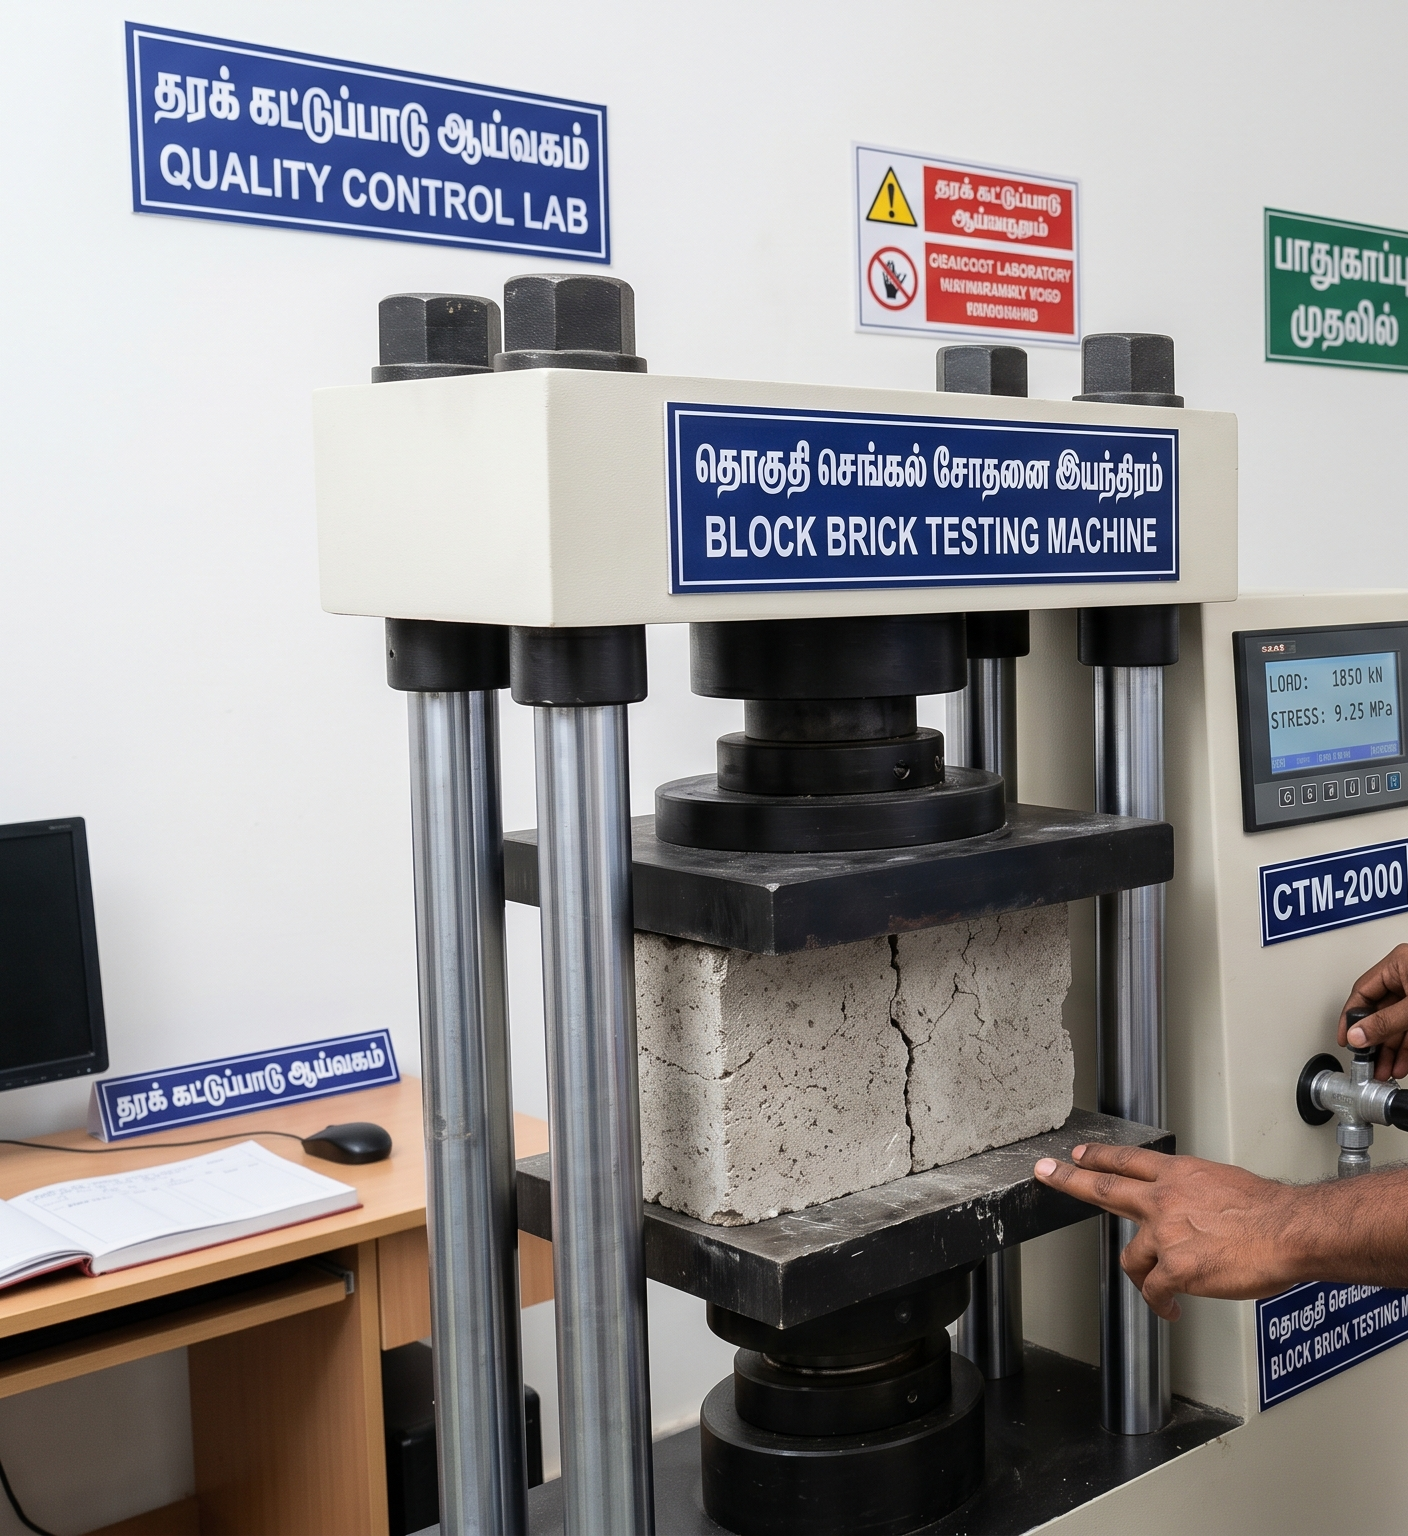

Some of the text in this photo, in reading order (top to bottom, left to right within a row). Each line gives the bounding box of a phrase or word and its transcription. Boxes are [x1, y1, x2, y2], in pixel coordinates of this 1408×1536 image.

[155, 66, 589, 170] தரக் கட்டுப்பாடு ஆய்வகம்
[160, 144, 588, 234] QUALITY CONTROL LAB
[997, 262, 1071, 282] LABORATORY
[1291, 299, 1398, 351] முதலில்
[696, 440, 1162, 503] தொகுதி செங்கல் சோதனை இயந்திரம்
[706, 516, 1156, 557] BLOCK BRICK TESTING MACHINE
[1270, 667, 1382, 693] LOAD: 1850 kN
[1271, 701, 1392, 729] STRESS: 9.25 MPa
[1274, 861, 1402, 920] CTM-2000
[116, 1042, 386, 1127] தரக் கட்டுப்பாடு ஆய்வகம்
[1269, 1292, 1325, 1343] தொகுதி
[1271, 1340, 1312, 1380] BLOCK
[1315, 1322, 1350, 1359] BRICK
[1353, 1300, 1399, 1340] TESTING
